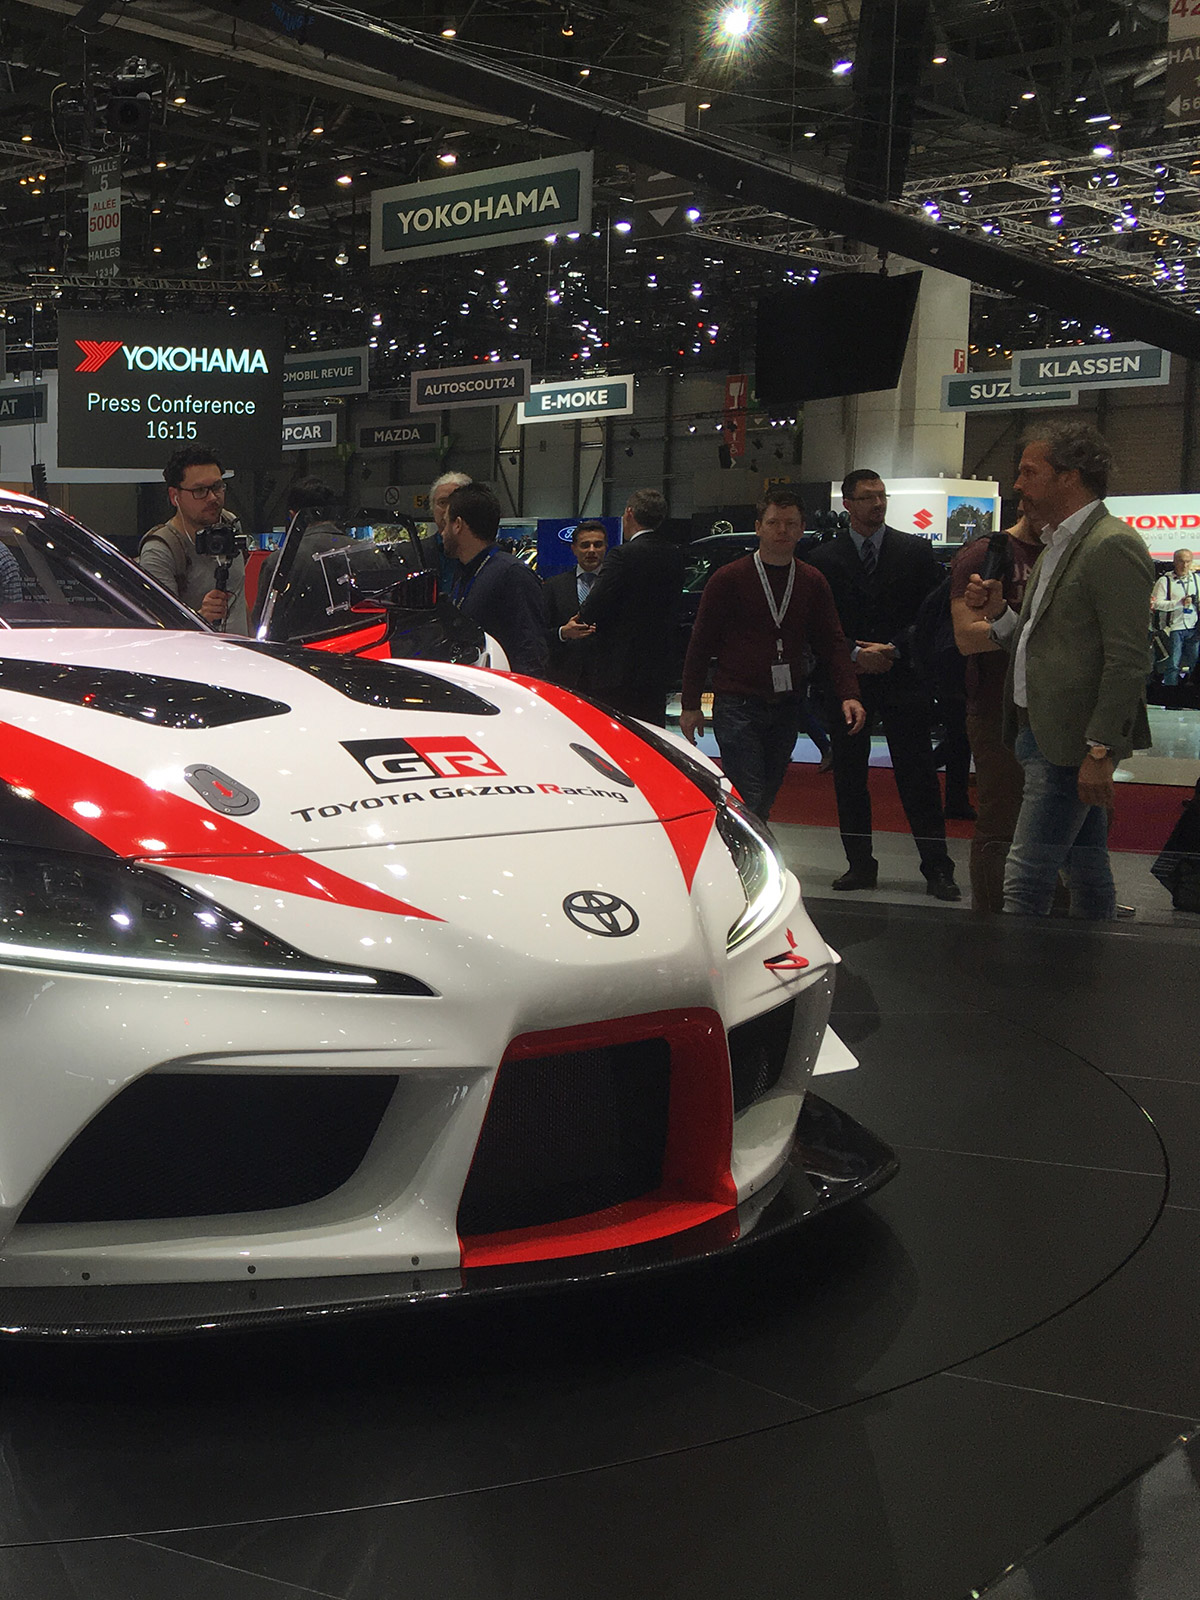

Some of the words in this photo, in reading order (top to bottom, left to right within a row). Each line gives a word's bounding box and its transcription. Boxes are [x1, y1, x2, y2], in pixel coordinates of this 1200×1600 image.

[91, 160, 119, 175] HALLE
[101, 174, 109, 191] 5
[93, 199, 117, 211] ALLÉE
[397, 185, 561, 235] YOKOHAMA
[90, 212, 120, 232] 5000
[88, 246, 121, 261] HALLES
[122, 346, 269, 374] YOKOHAMA
[1039, 355, 1141, 379] KLASSEN
[321, 366, 353, 379] REVUE
[424, 376, 515, 396] AUTOSCOUT24
[970, 382, 1047, 400] SUZ
[87, 392, 141, 412] Press
[147, 394, 256, 415] Conference
[541, 389, 608, 411] E-MOKE
[147, 420, 198, 439] 16:15
[282, 425, 322, 440] PCAR
[374, 428, 421, 442] MAZDA
[363, 751, 501, 781] GR
[290, 791, 425, 823] TOYOTA
[429, 784, 535, 800] GAZOO
[536, 783, 629, 803] Racing
